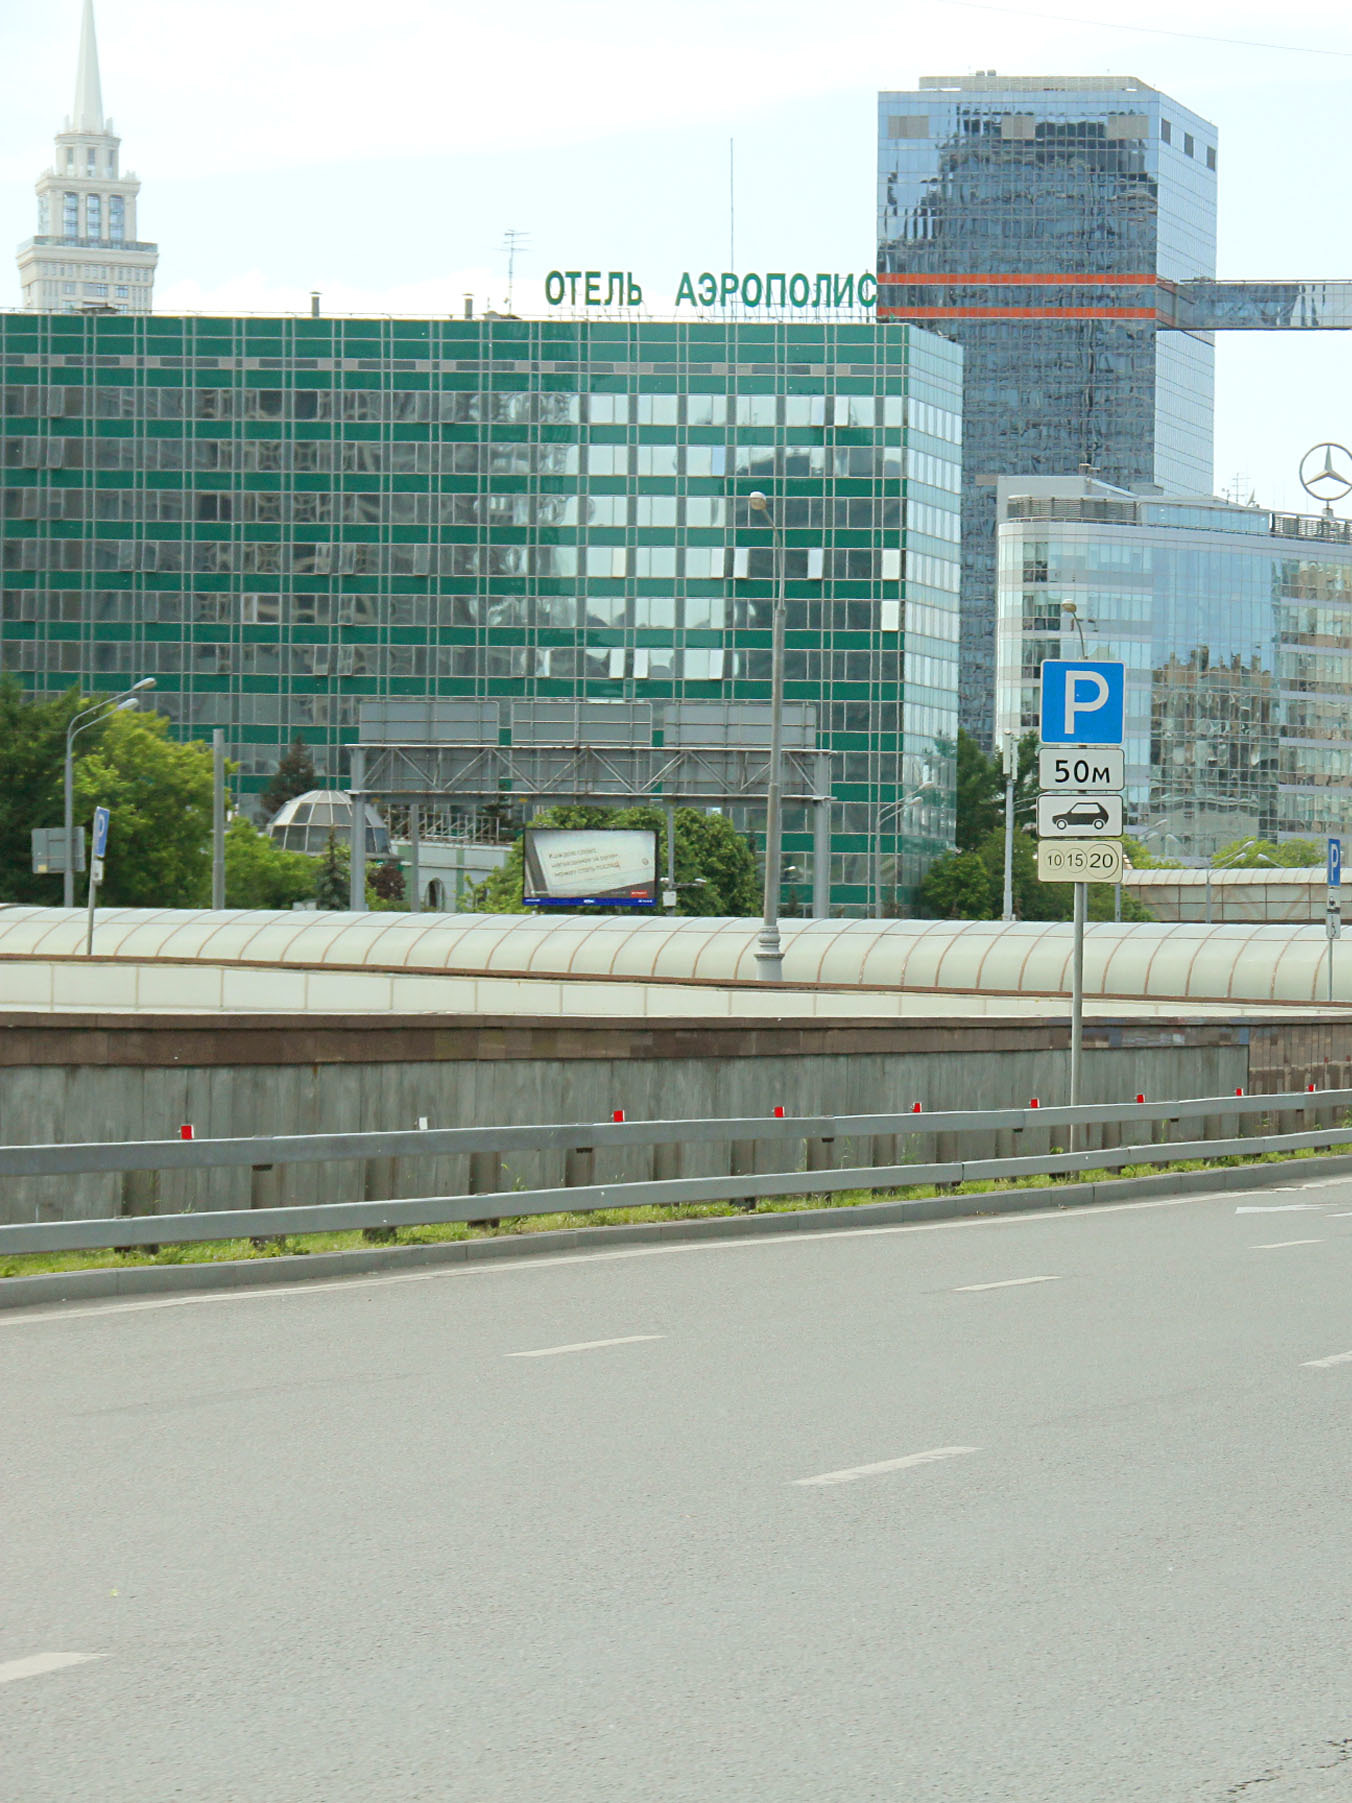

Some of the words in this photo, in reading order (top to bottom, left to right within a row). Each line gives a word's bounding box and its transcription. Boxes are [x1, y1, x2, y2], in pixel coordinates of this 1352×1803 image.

[545, 270, 642, 306] ОТЕЛЬ
[675, 272, 877, 308] АЭРОПОЛИС
[1064, 670, 1110, 735] P
[1047, 855, 1062, 867] 10
[1067, 854, 1084, 867] 15
[1089, 853, 1113, 868] 20
